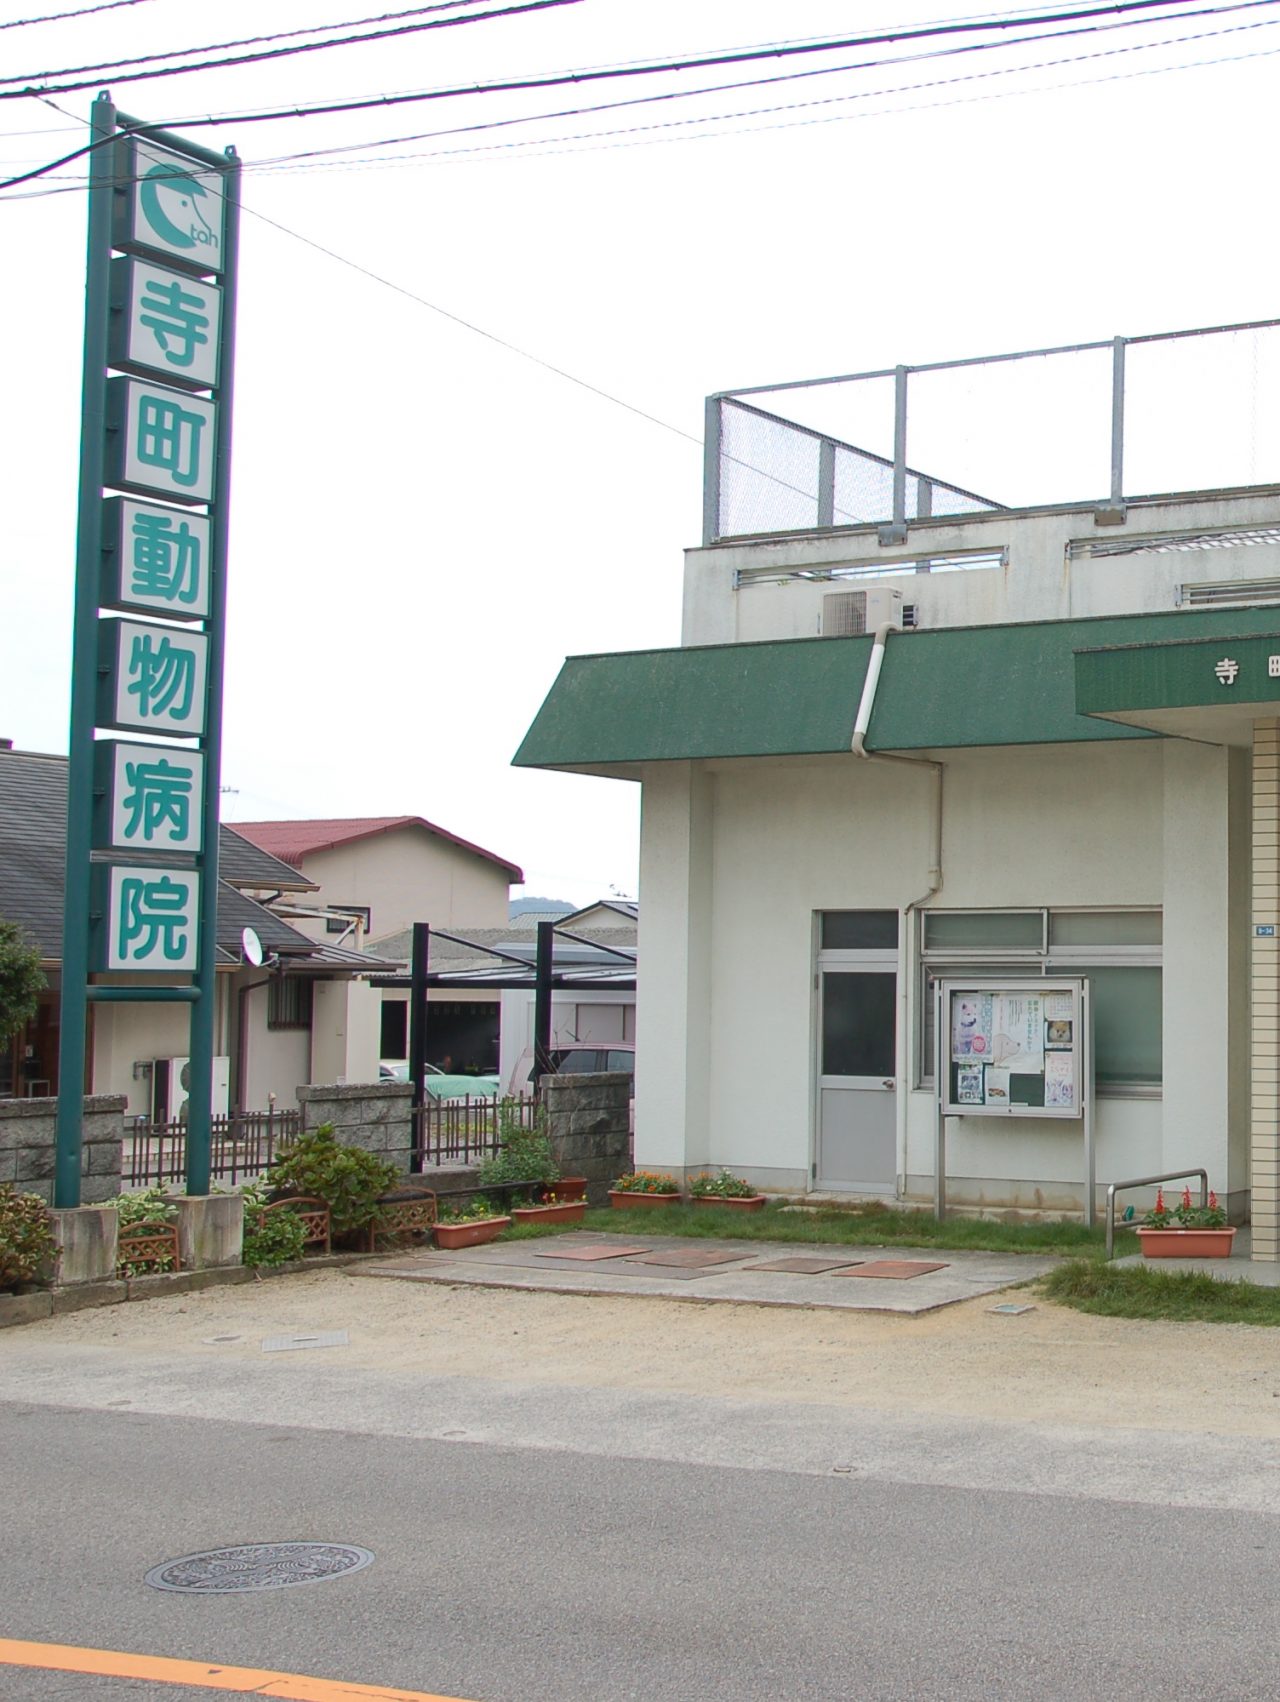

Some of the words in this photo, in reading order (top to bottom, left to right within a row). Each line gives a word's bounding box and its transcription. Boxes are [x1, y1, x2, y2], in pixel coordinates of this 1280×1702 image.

[190, 222, 218, 248] tah
[118, 280, 208, 961] 寺町動物病院
